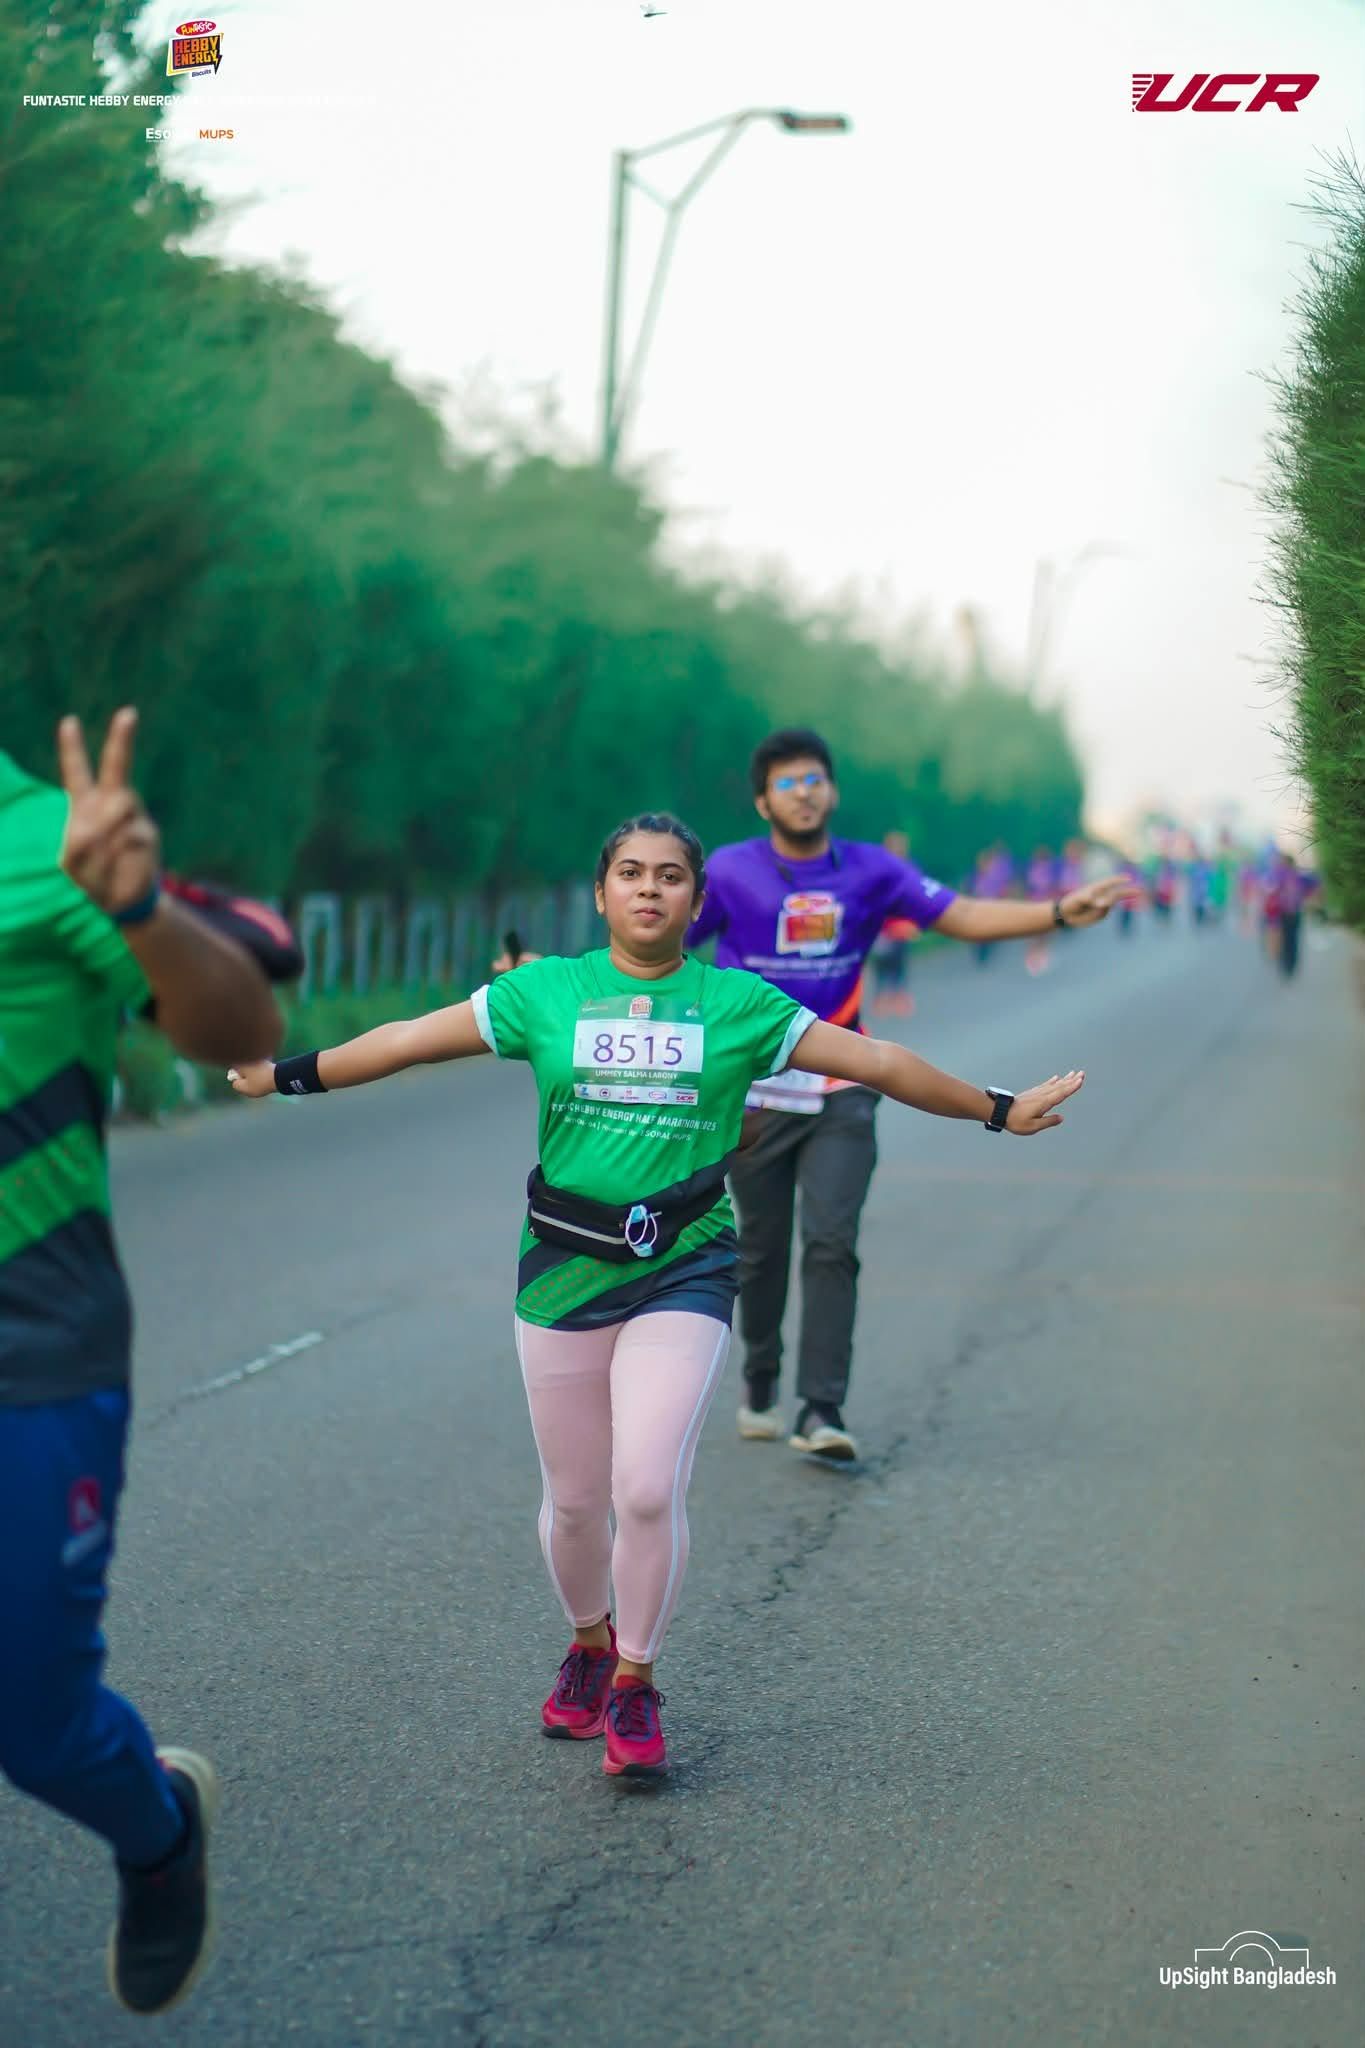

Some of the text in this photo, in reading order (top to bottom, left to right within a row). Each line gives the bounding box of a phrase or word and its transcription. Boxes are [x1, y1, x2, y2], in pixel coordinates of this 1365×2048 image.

[593, 1033, 683, 1066] 8515
[623, 1070, 647, 1079] SALMA
[602, 1107, 635, 1122] ENERGY
[657, 1115, 701, 1130] MARATHON
